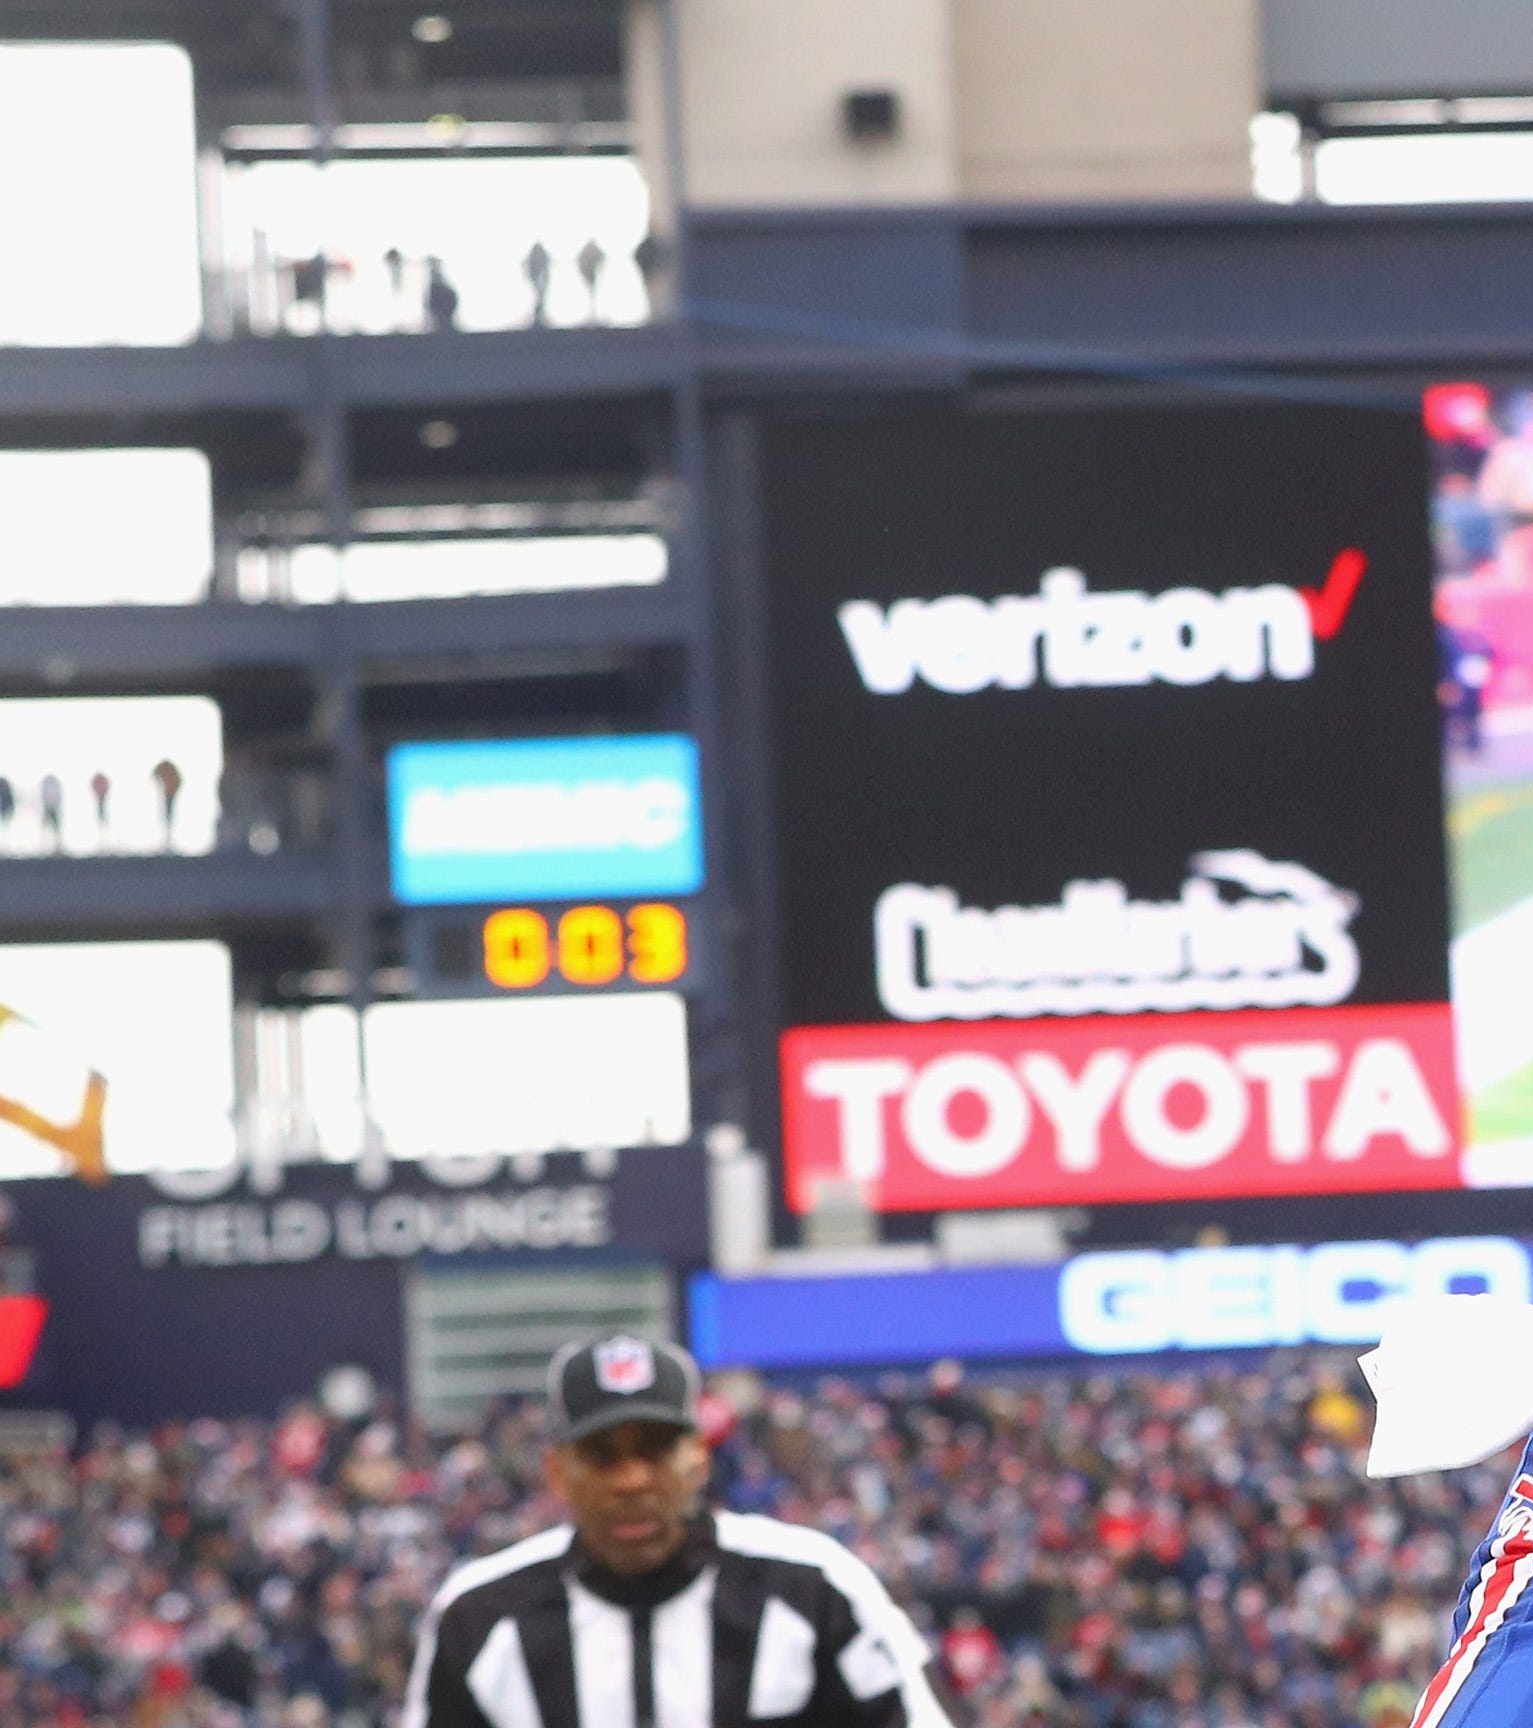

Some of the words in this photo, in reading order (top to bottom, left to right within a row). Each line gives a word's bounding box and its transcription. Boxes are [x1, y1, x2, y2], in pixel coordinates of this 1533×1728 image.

[838, 567, 1313, 694] verizon
[803, 1038, 1454, 1182] TOYOTA
[137, 1200, 331, 1268] FIELD
[336, 1185, 614, 1261] LOUNGE
[1057, 1235, 1533, 1355] GEICO
